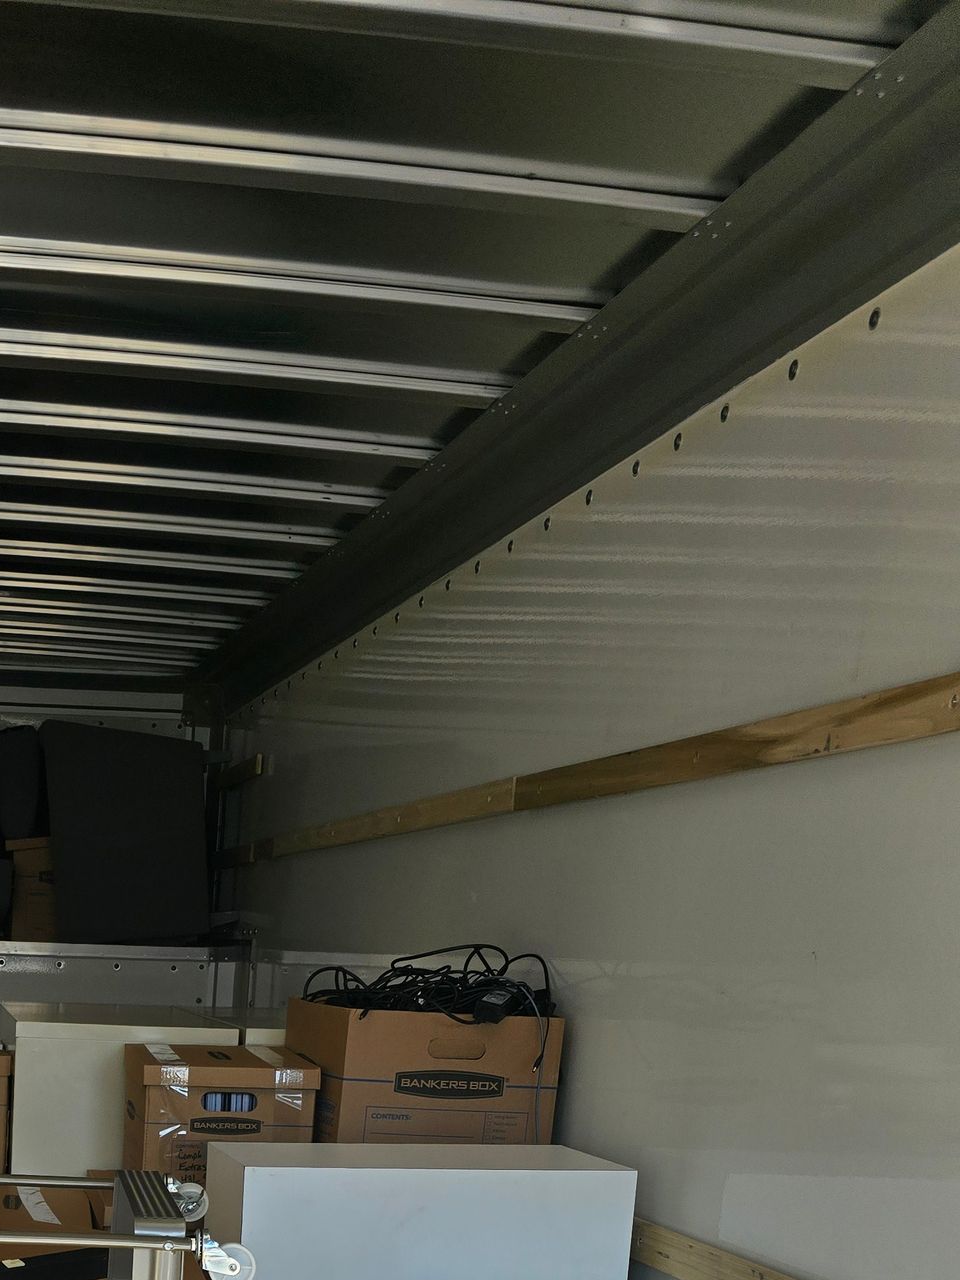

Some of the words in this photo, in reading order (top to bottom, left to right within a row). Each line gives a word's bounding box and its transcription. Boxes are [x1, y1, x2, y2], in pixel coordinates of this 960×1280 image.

[401, 1078, 468, 1090] BANKERS
[469, 1081, 498, 1091] BOX
[371, 1112, 412, 1121] CONTENTS:
